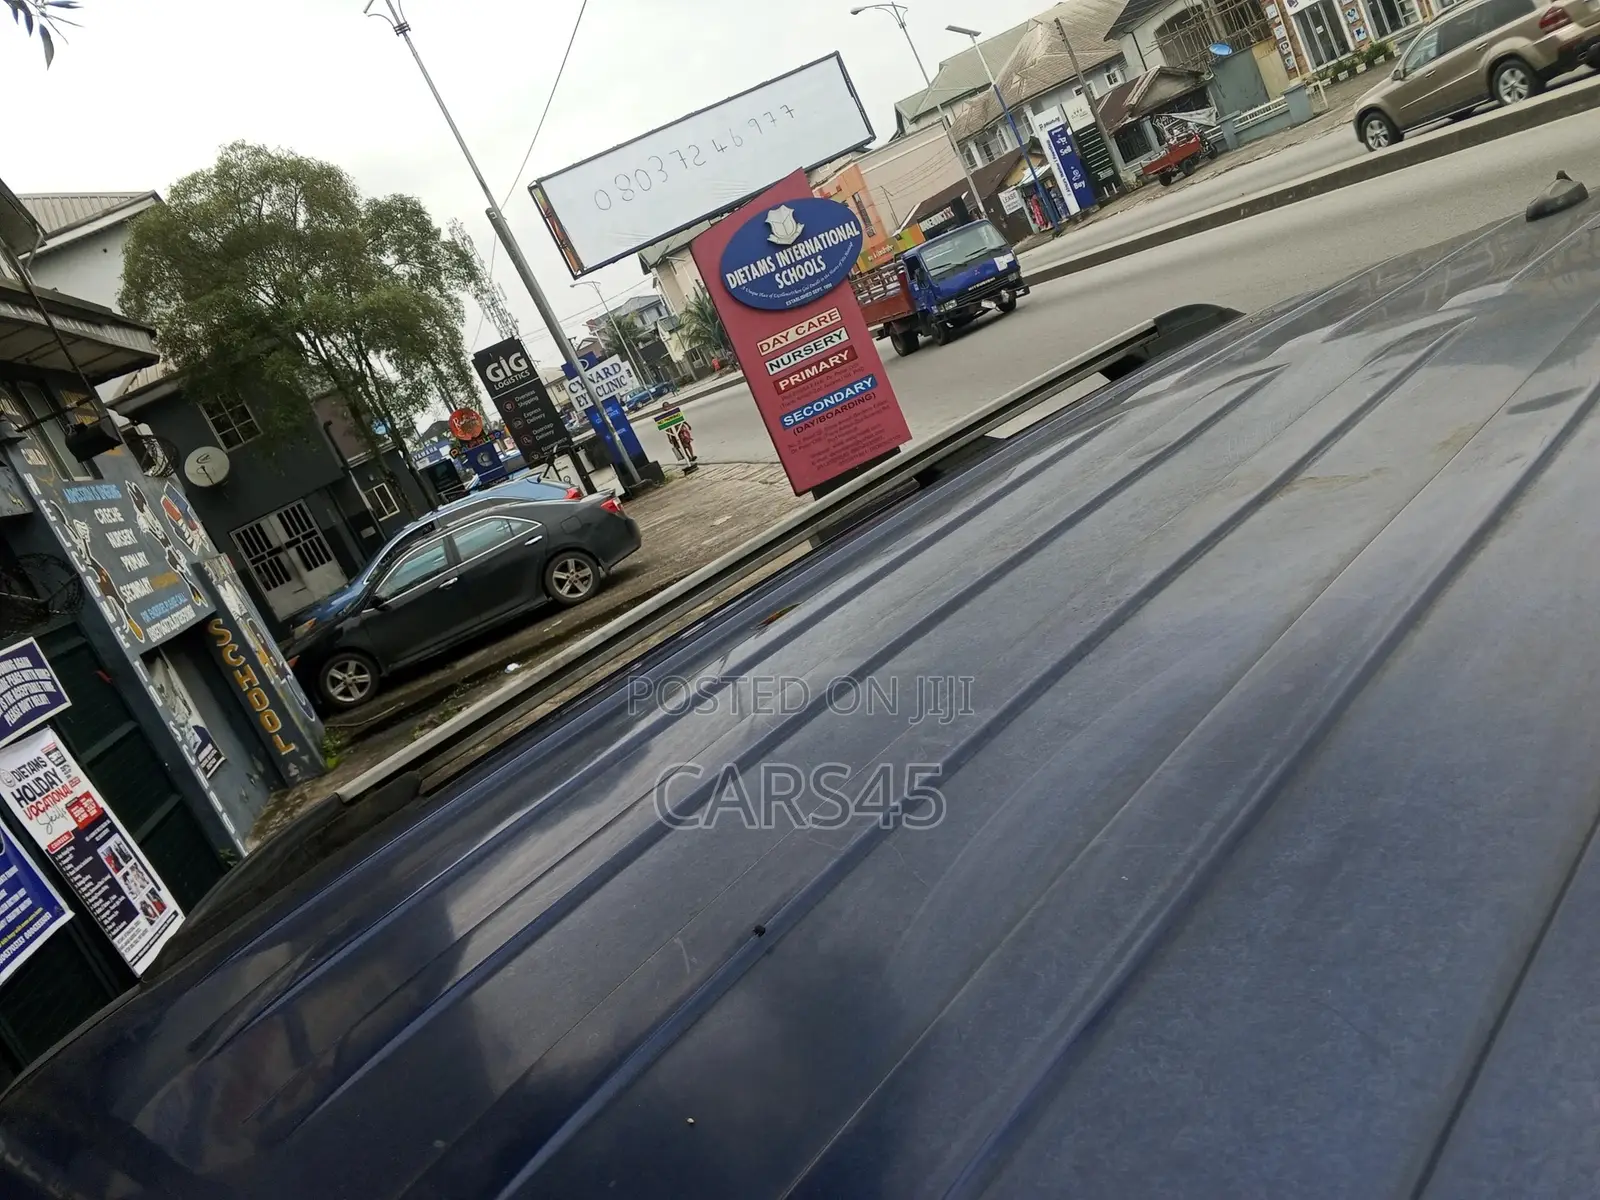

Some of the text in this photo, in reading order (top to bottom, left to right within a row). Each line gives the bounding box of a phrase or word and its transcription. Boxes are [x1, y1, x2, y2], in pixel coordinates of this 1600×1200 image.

[725, 255, 776, 290] DIETAMS
[775, 220, 861, 269] INTERNATIONAL
[775, 255, 827, 289] SCHOOLS
[759, 310, 841, 355] DAY CARE
[768, 329, 845, 373] NURSERY
[494, 370, 530, 391] LOGISTICS
[596, 375, 628, 398] CLINIC
[778, 350, 850, 391] PRIMARY
[783, 377, 874, 427] SECONDARY
[793, 392, 877, 436] (DAY/BOARDING)
[94, 506, 125, 525] CRECHE
[105, 528, 138, 549] NURSERY
[120, 551, 150, 573] PRIMARY
[119, 576, 154, 604] SECONDARY
[208, 617, 296, 756] SCHOOL
[11, 756, 48, 782] DIETAMS
[11, 767, 63, 809] HOLIDAY
[23, 784, 73, 821] VOCATIONAL
